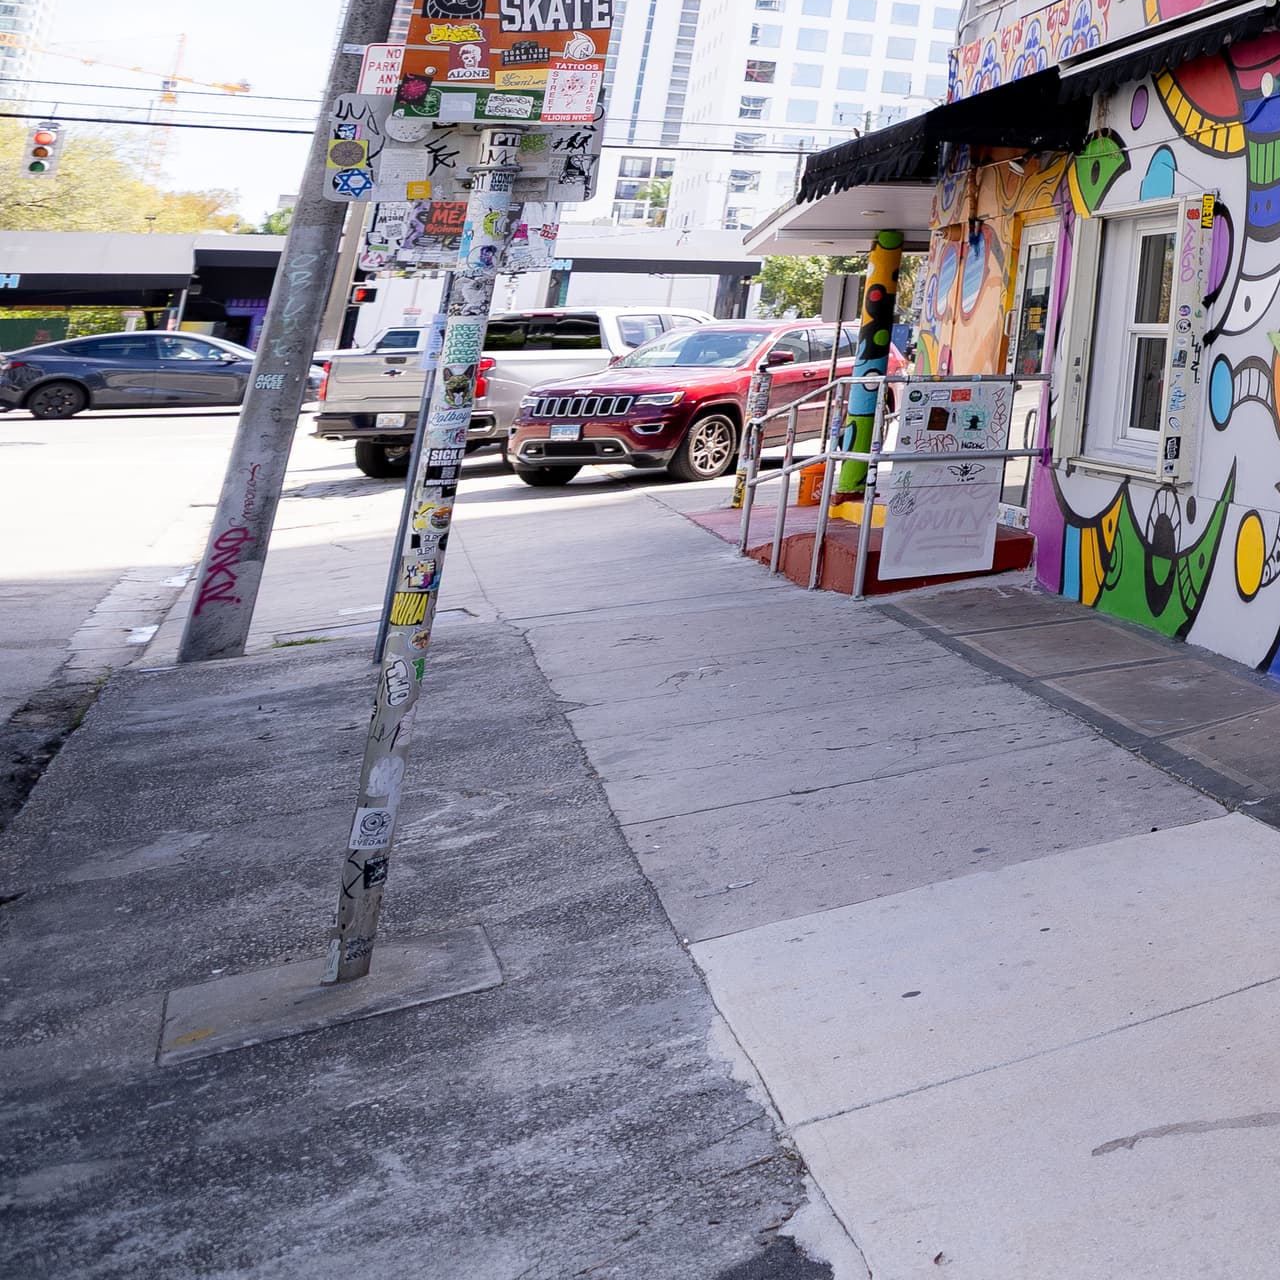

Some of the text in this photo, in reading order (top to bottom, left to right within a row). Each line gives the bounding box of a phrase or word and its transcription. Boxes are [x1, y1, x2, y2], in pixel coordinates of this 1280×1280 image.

[387, 49, 401, 59] NO
[368, 62, 400, 71] PARKI
[555, 62, 599, 70] TATTOOS
[448, 69, 489, 80] ALONE
[586, 73, 598, 112] DREAMS
[1202, 195, 1214, 228] DREW
[431, 449, 457, 460] SICK
